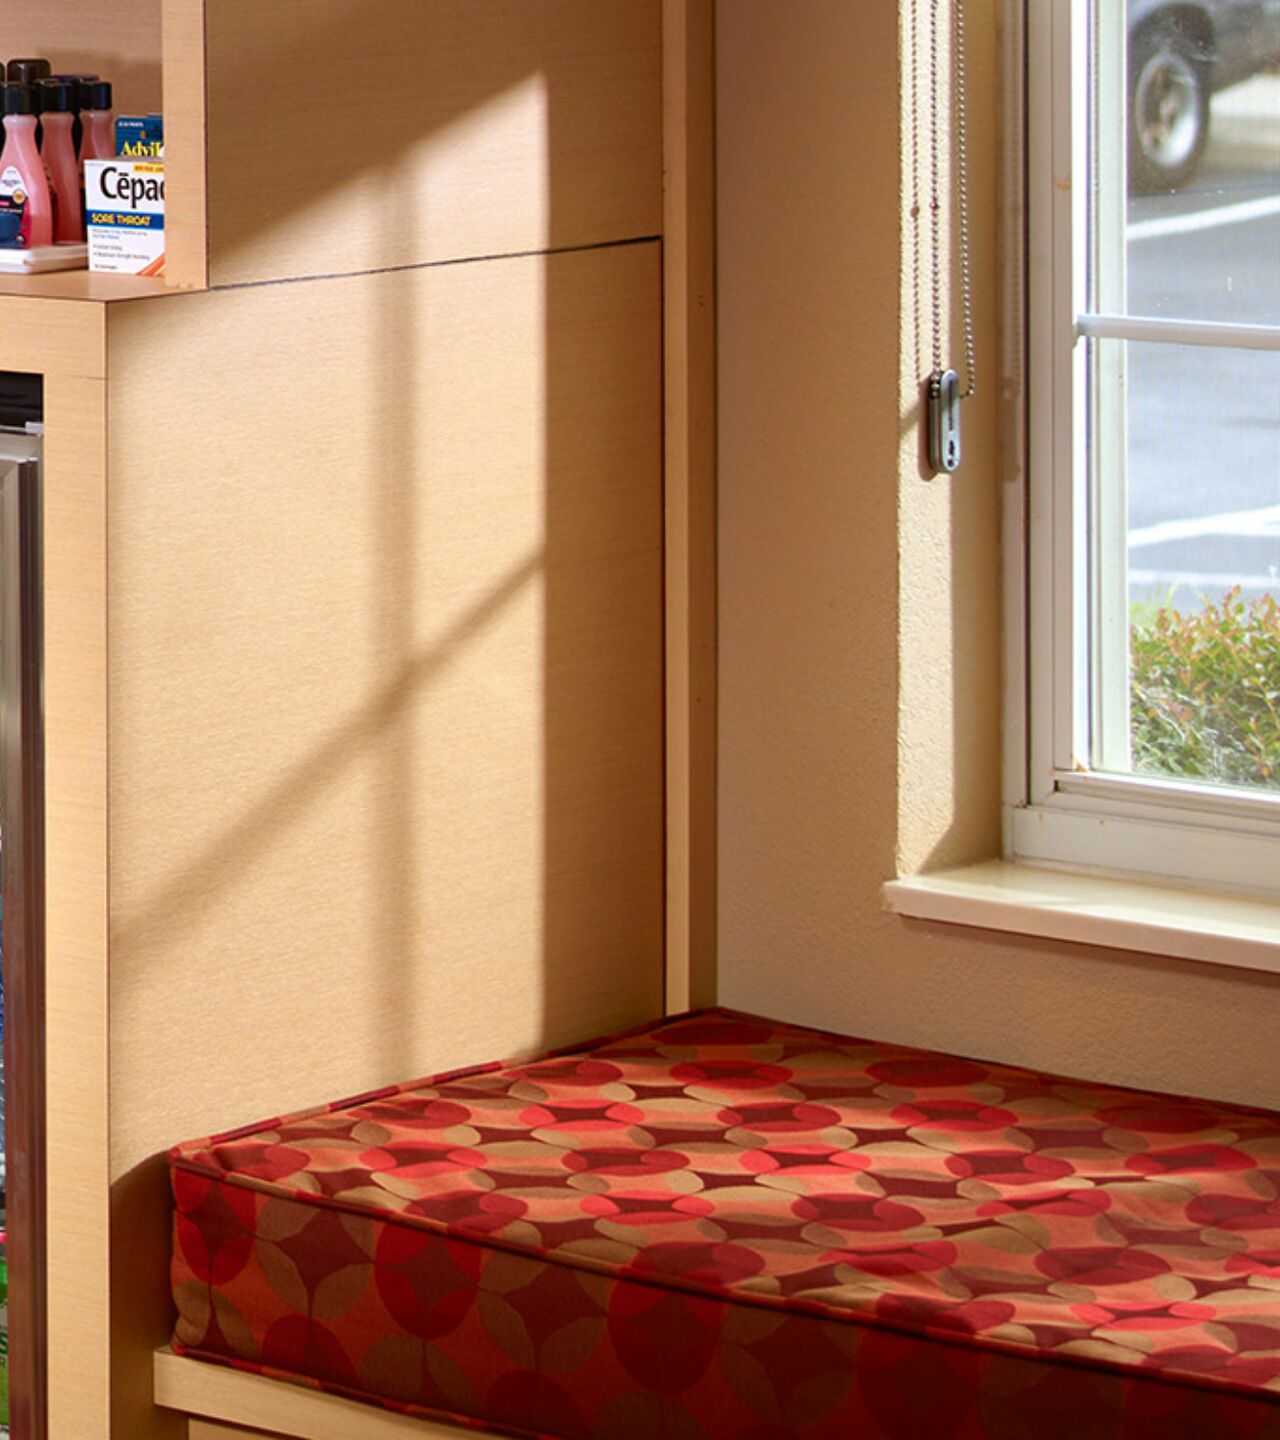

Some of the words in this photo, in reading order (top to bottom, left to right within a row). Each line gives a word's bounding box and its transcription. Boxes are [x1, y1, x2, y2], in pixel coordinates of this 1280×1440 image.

[121, 140, 161, 157] Advil
[100, 166, 165, 210] Cēpa
[92, 213, 115, 224] SORE
[117, 215, 151, 226] THROAT
